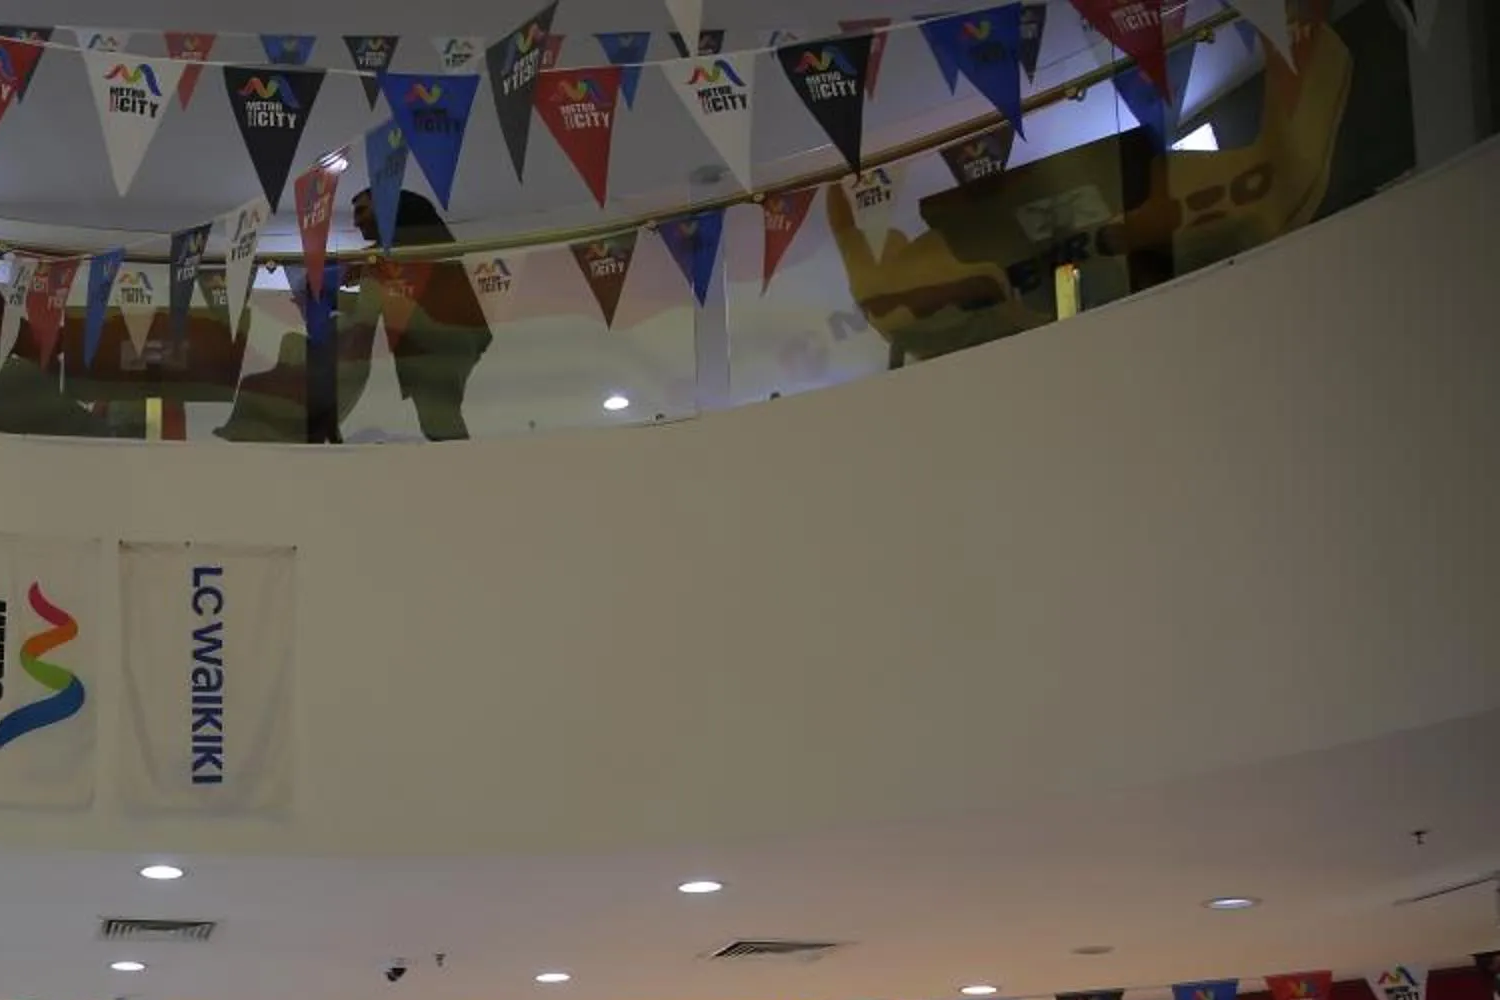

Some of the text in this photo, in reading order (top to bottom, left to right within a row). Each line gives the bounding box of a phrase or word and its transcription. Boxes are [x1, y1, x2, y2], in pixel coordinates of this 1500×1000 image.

[820, 81, 857, 98] CITY
[119, 97, 159, 118] CITY
[711, 94, 748, 113] CITY
[257, 112, 297, 129] CITY
[573, 110, 612, 129] CITY
[192, 566, 223, 616] LC
